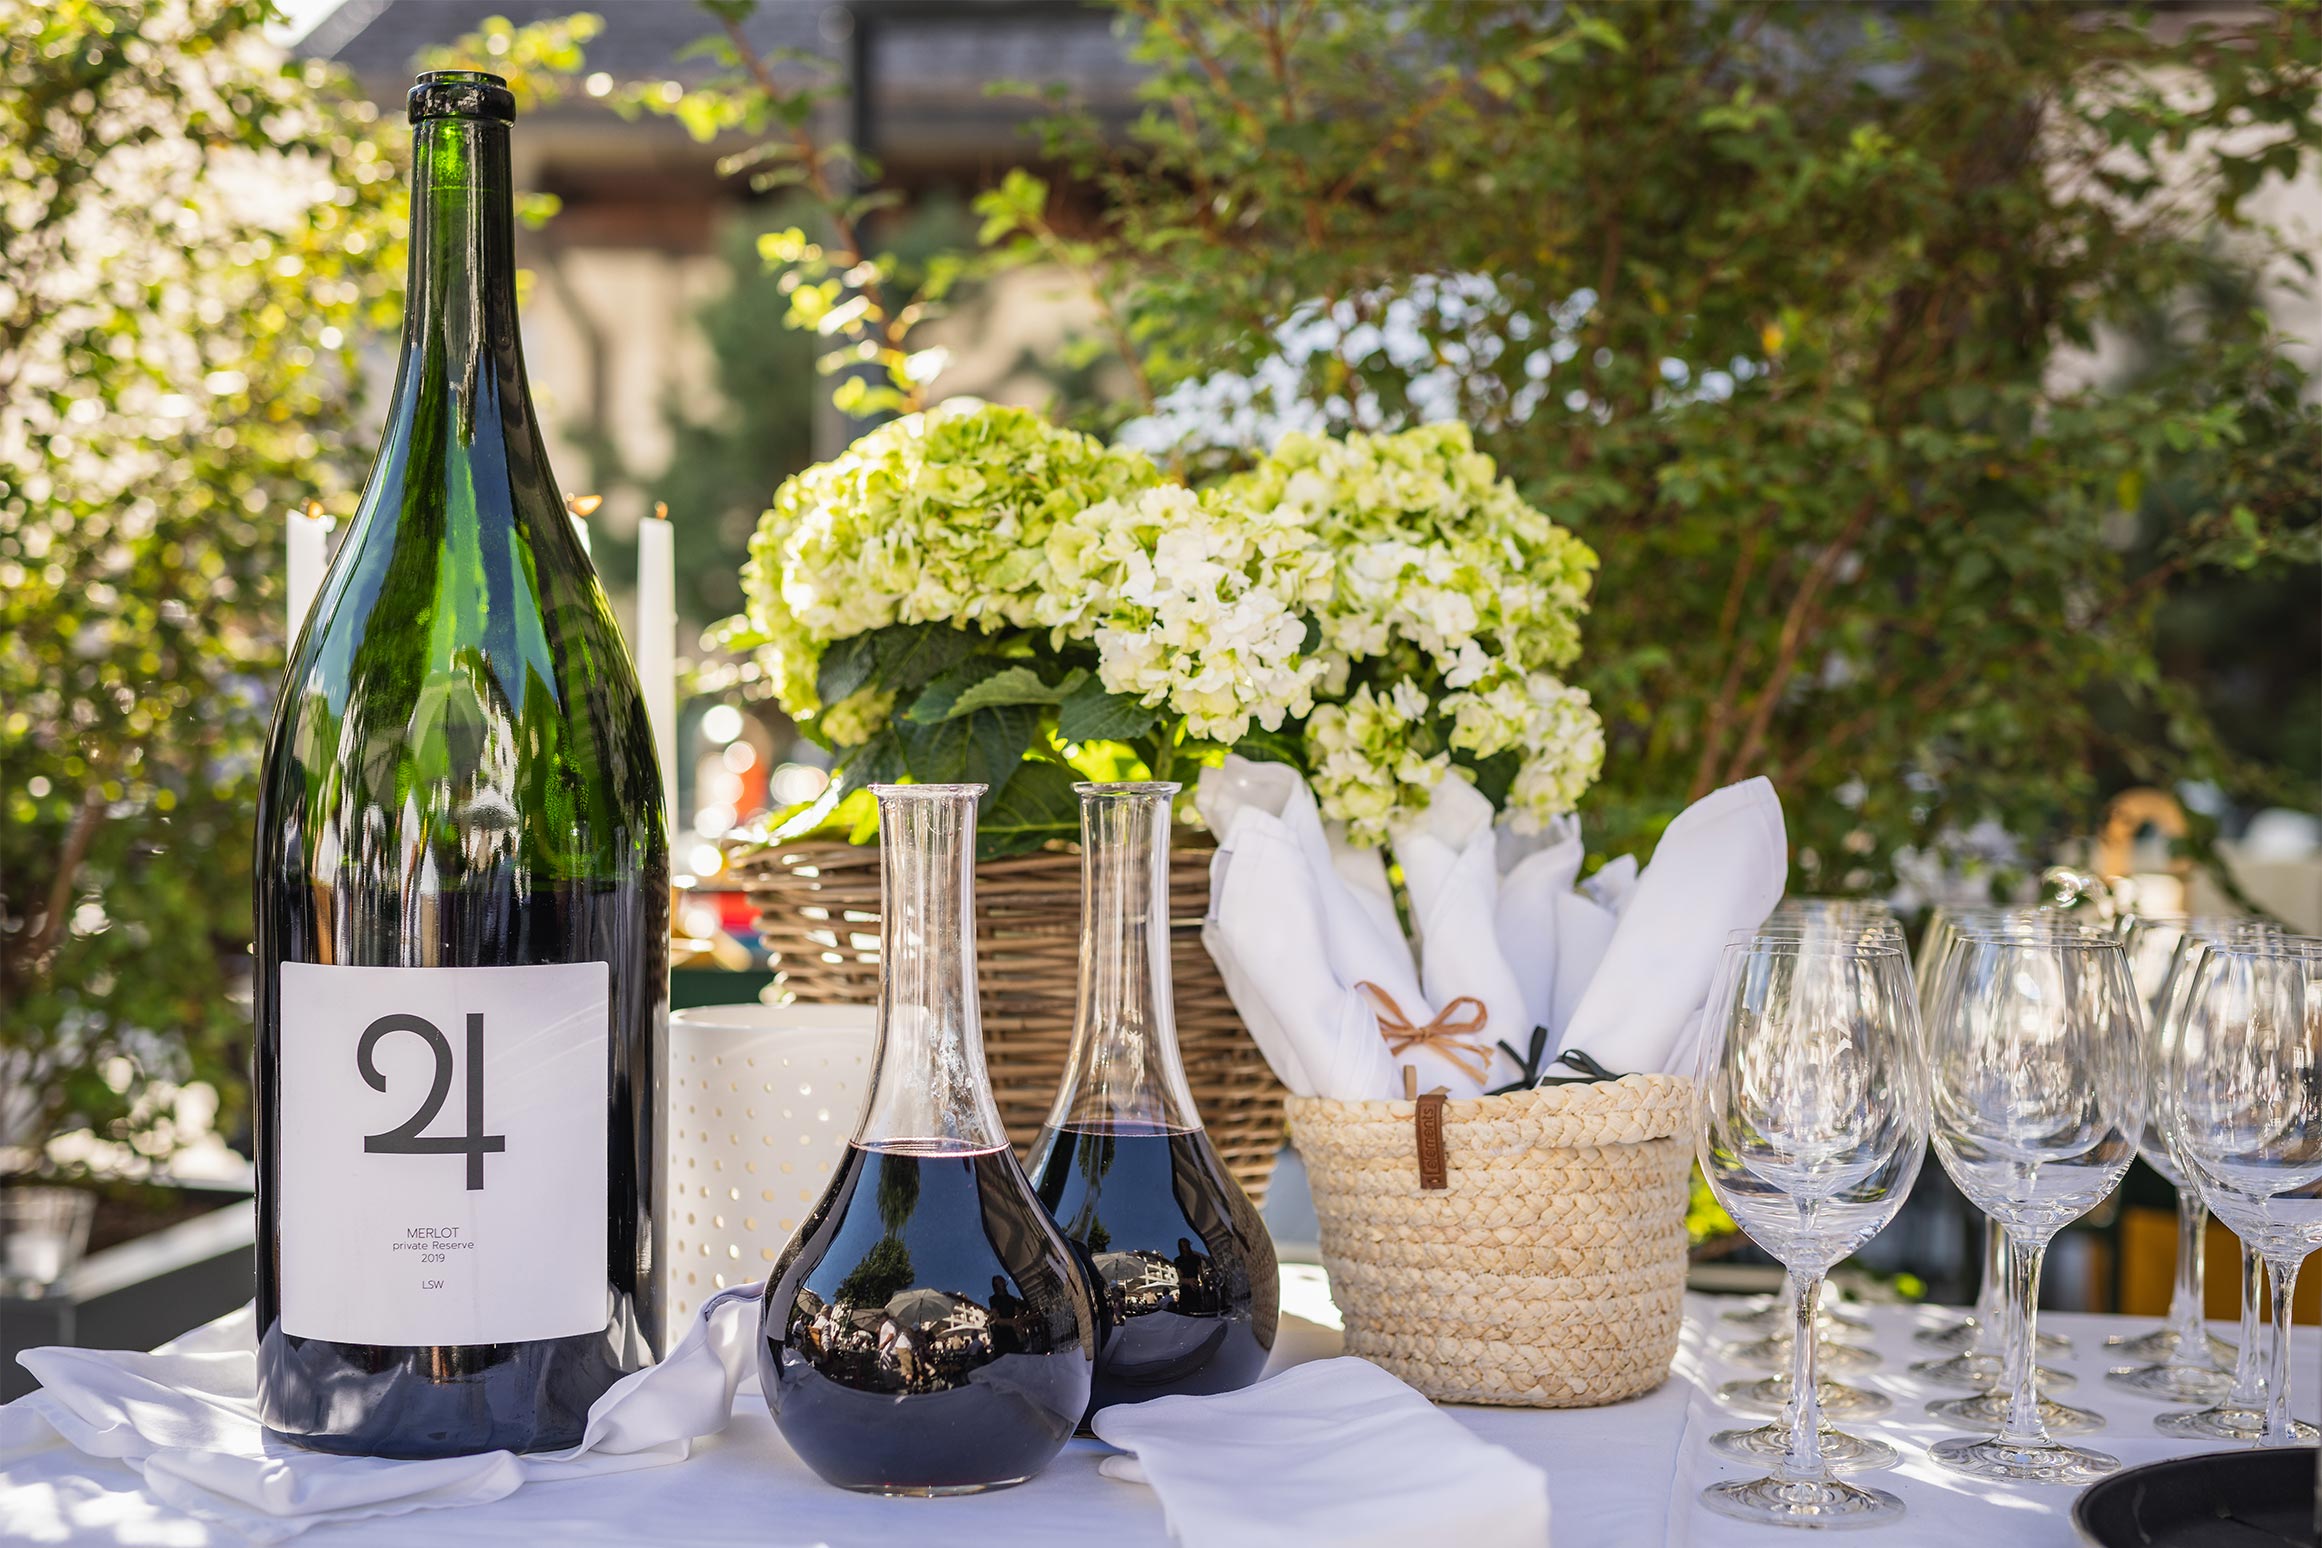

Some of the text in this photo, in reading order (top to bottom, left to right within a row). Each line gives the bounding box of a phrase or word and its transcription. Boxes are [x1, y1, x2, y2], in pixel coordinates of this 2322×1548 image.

[1423, 1106, 1437, 1170] elements
[407, 1227, 459, 1239] MERLOT
[392, 1240, 475, 1252] private Reserve
[421, 1253, 446, 1263] 2019
[422, 1279, 445, 1290] LSW
